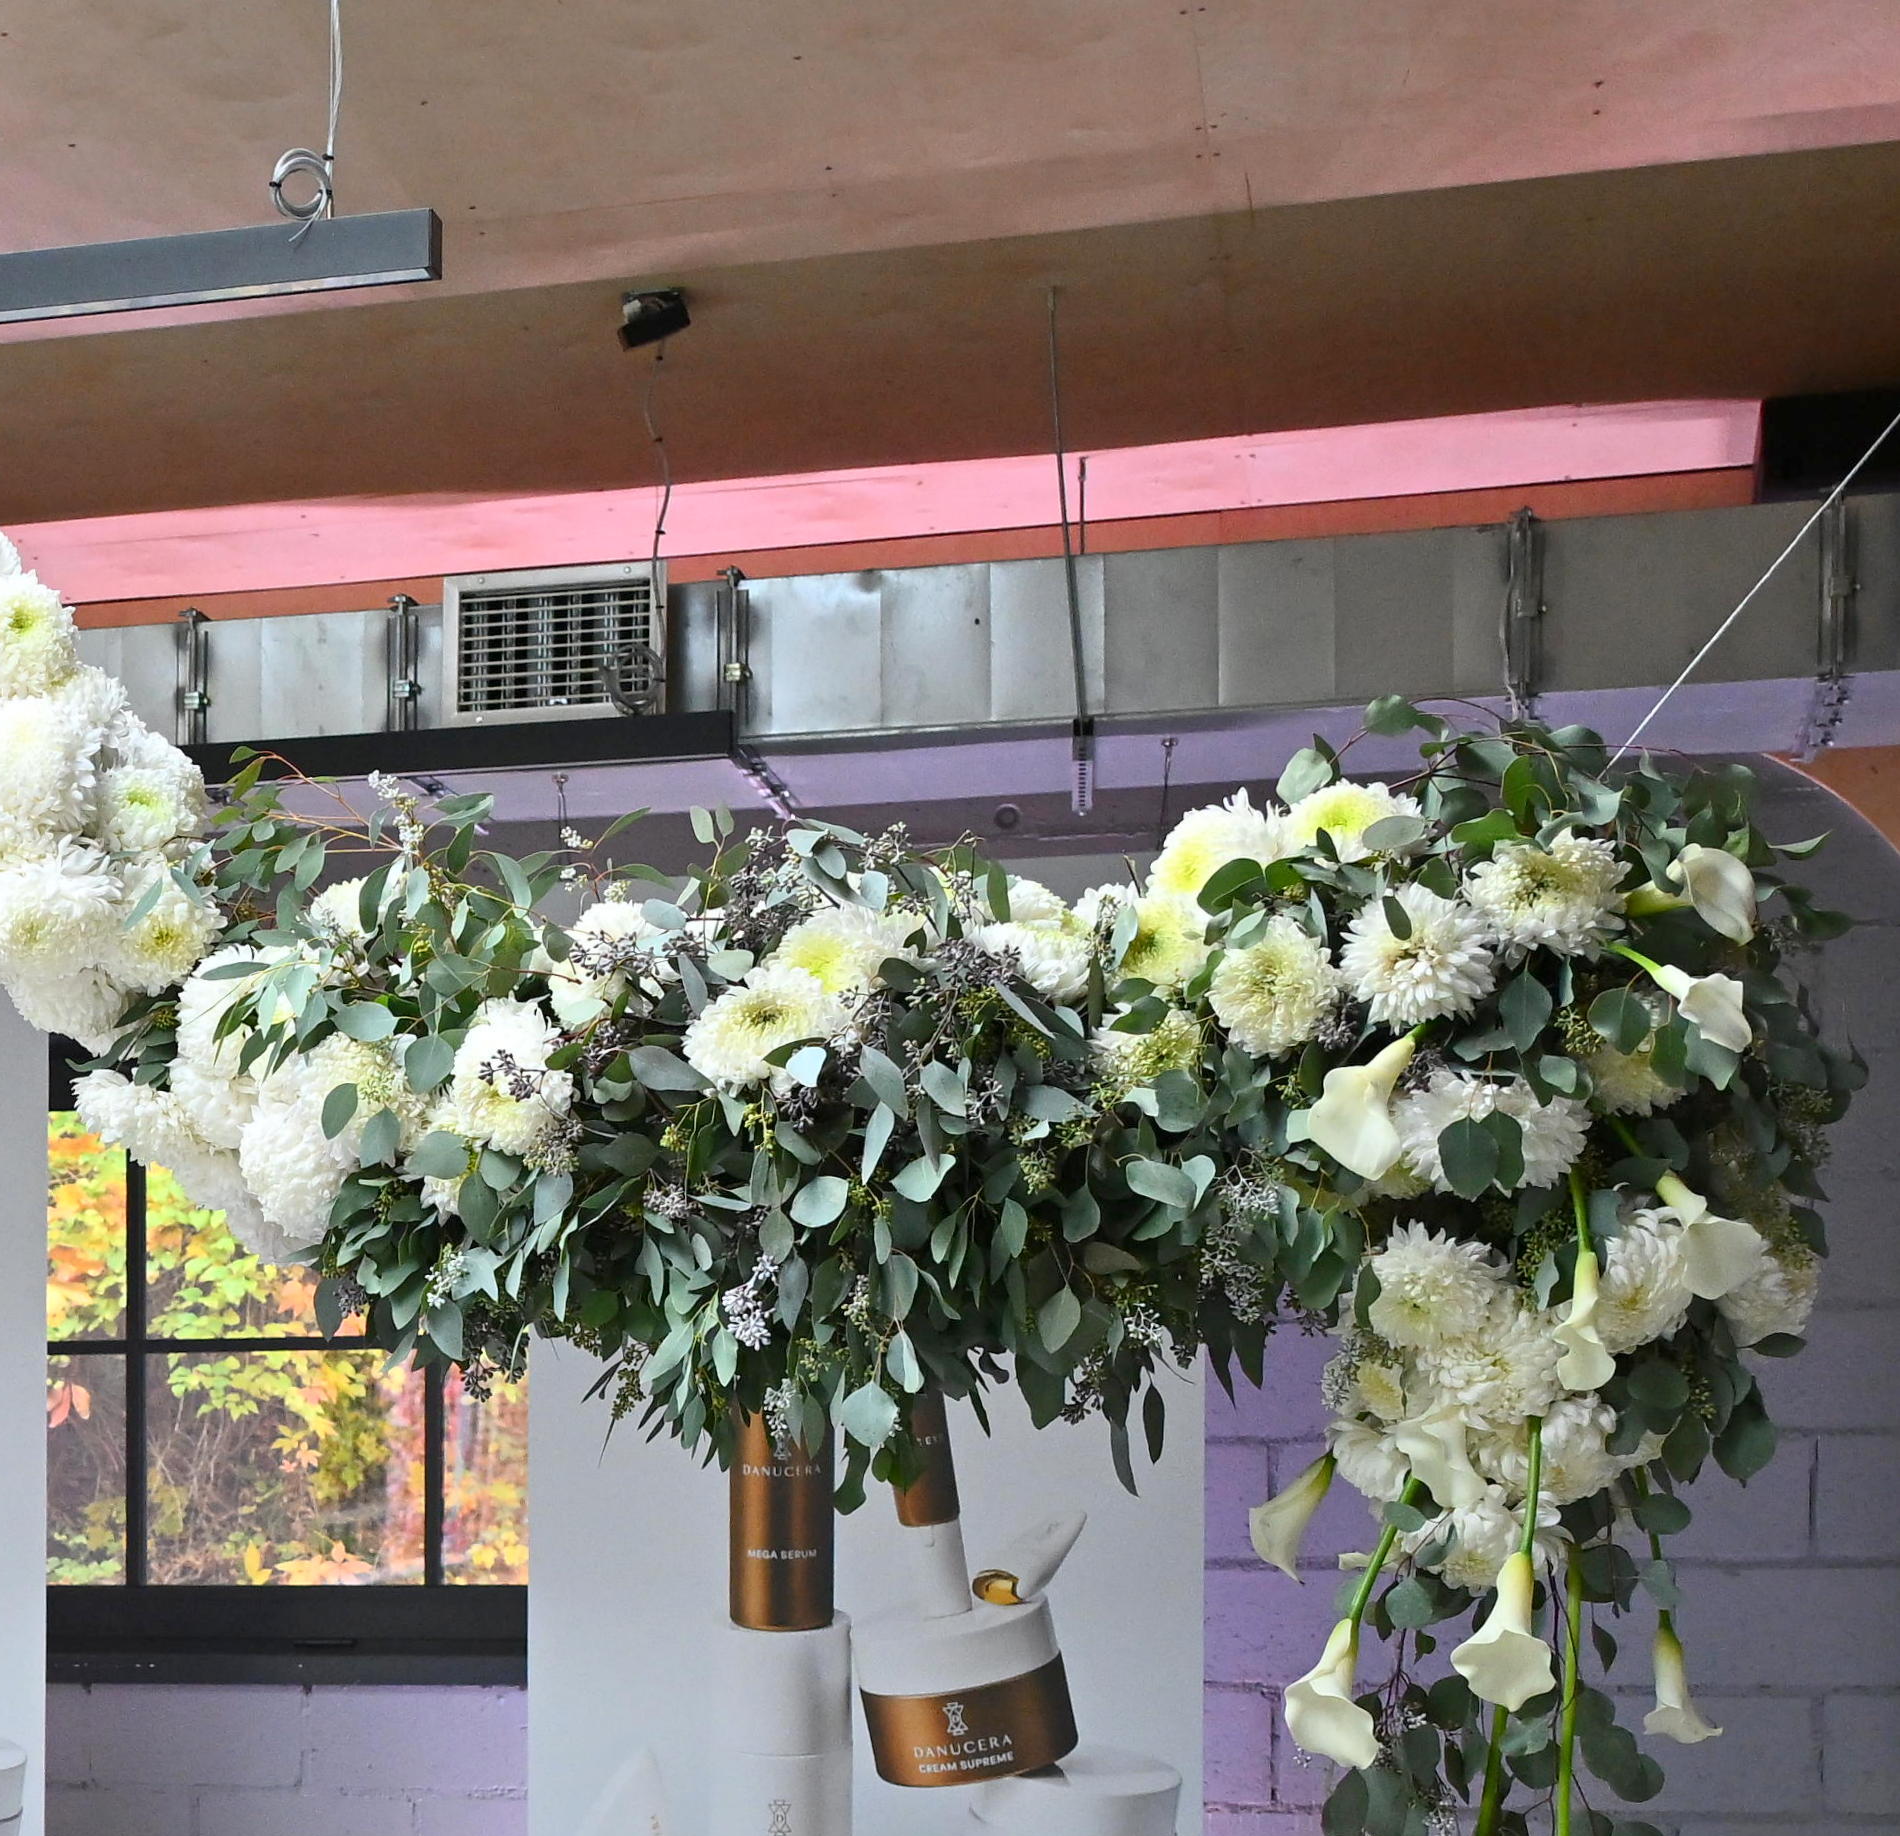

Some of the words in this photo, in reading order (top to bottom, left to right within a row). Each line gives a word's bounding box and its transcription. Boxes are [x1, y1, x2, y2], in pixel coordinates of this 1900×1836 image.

[742, 1463, 821, 1477] DANUCERA
[746, 1549, 778, 1559] MEGA
[781, 1549, 817, 1560] SERUM
[913, 1734, 1013, 1759] DANUCERA
[918, 1762, 958, 1774] CREAM
[960, 1751, 1014, 1770] SUPREME
